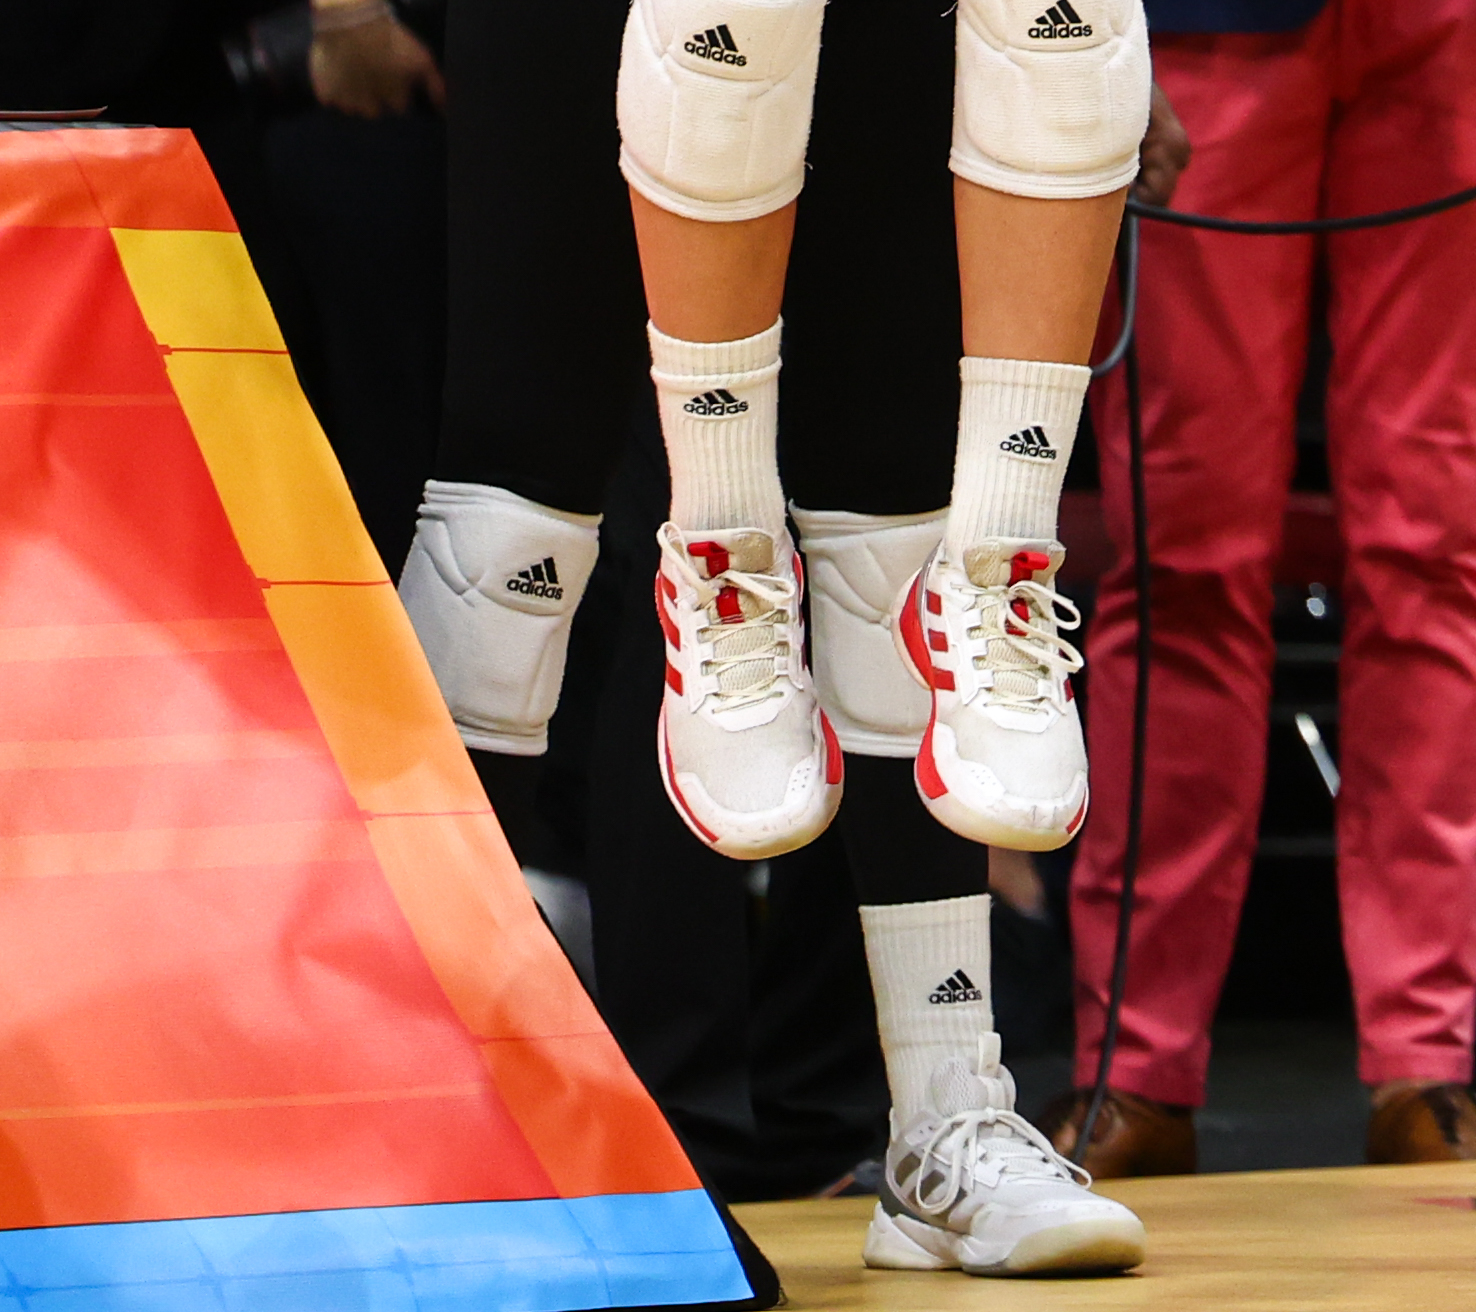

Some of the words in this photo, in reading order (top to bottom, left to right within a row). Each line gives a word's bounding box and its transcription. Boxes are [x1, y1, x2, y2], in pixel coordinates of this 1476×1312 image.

[1028, 23, 1093, 39] adidas
[684, 40, 747, 67] adidas
[683, 399, 749, 416] adidas
[1000, 440, 1057, 460] adidas
[506, 577, 563, 601] adidas
[929, 987, 983, 1004] adidas
